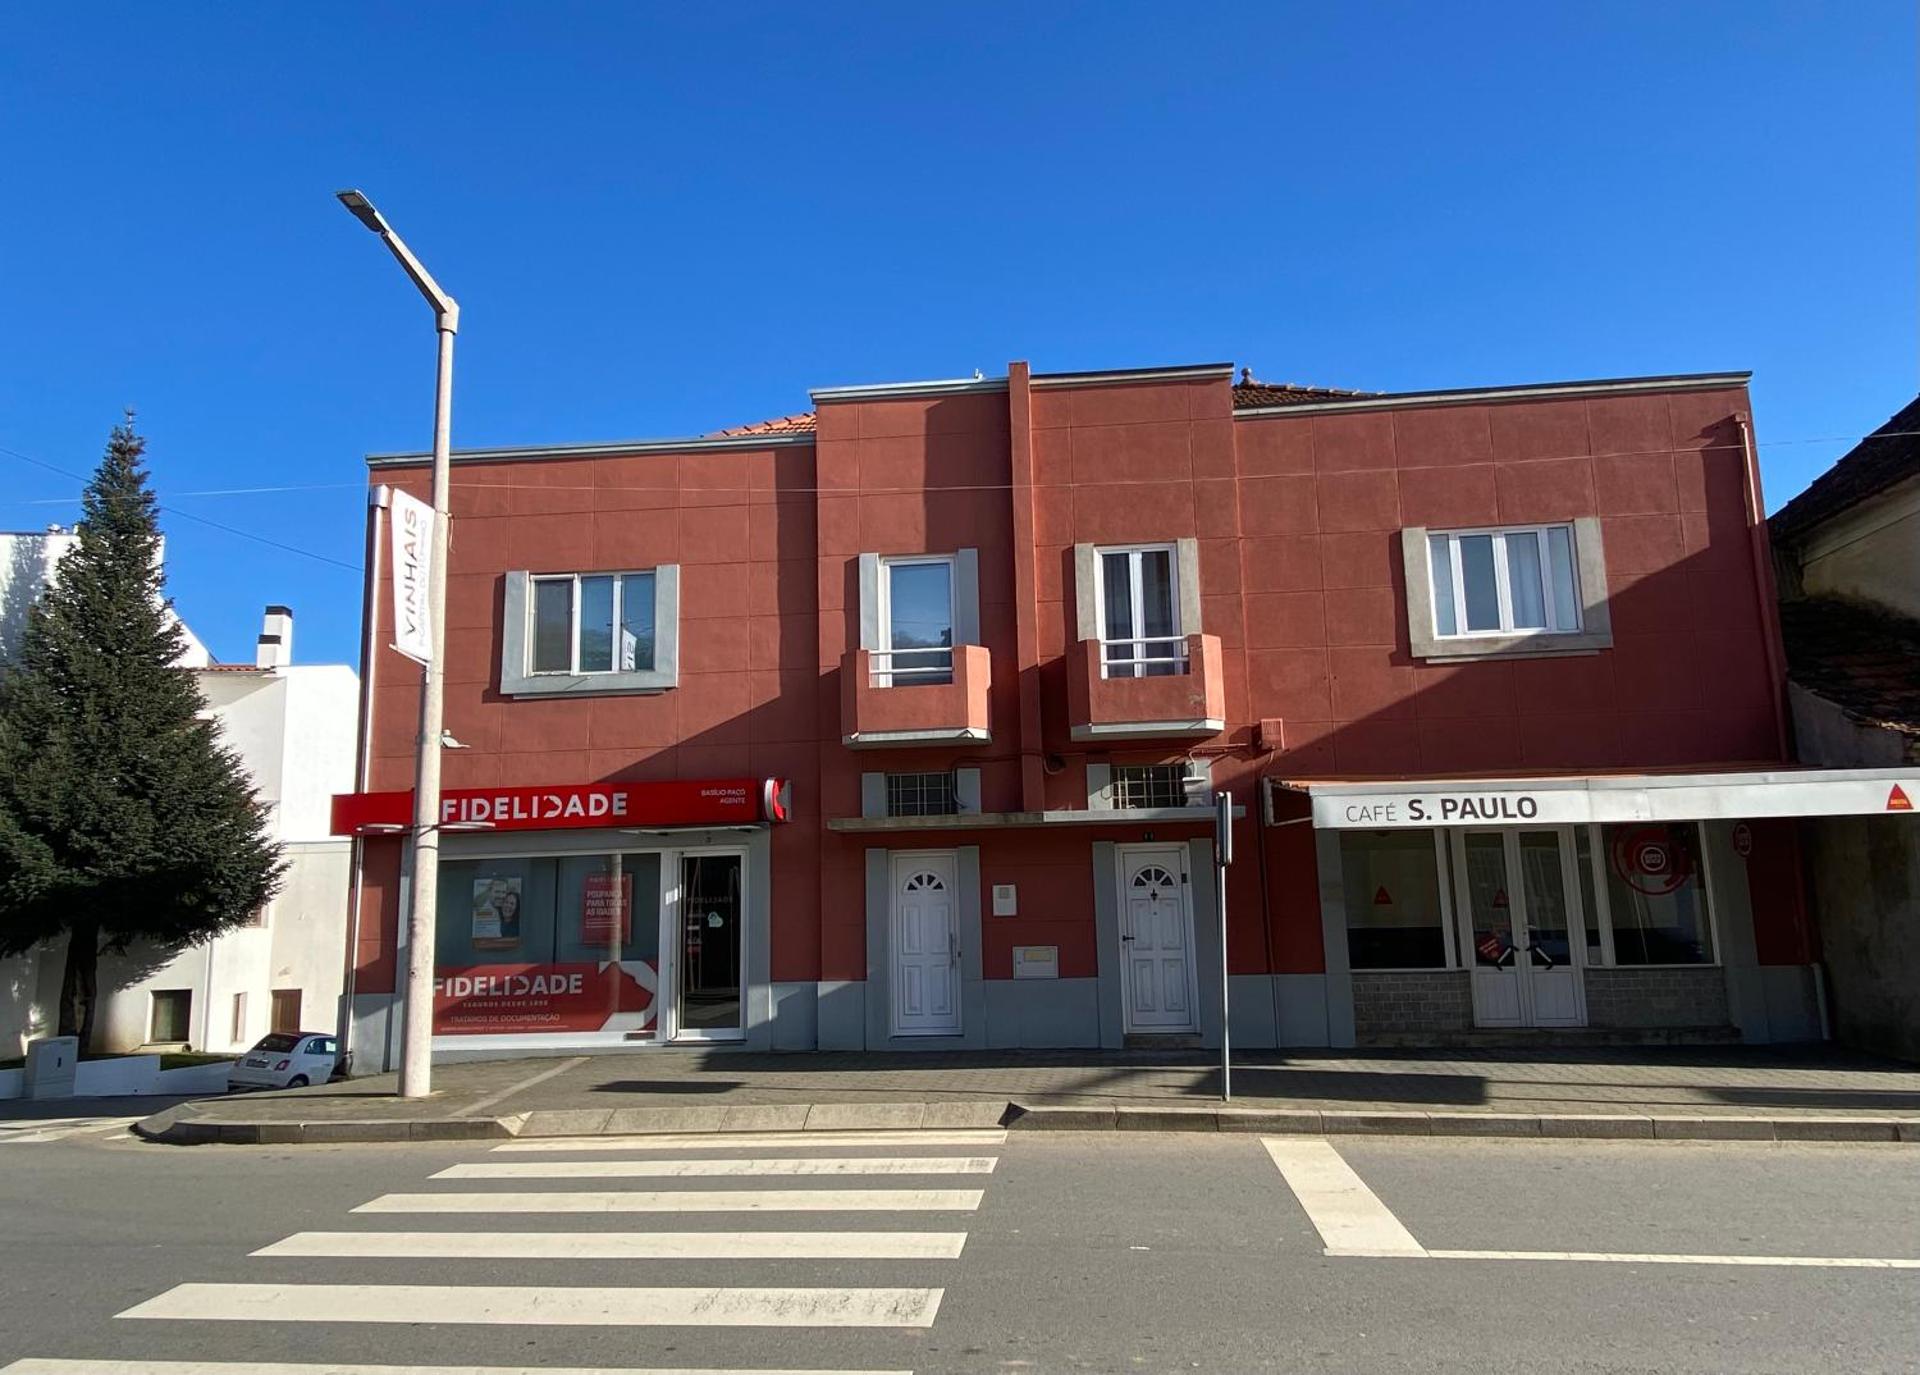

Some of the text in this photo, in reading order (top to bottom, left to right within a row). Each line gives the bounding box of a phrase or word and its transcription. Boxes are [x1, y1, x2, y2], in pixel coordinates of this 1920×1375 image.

[404, 508, 417, 635] VINHAIS
[442, 792, 628, 822] FIDELIDADE
[1346, 797, 1538, 822] CAFÉ S. PAULO
[433, 974, 584, 997] FIDELIDADE
